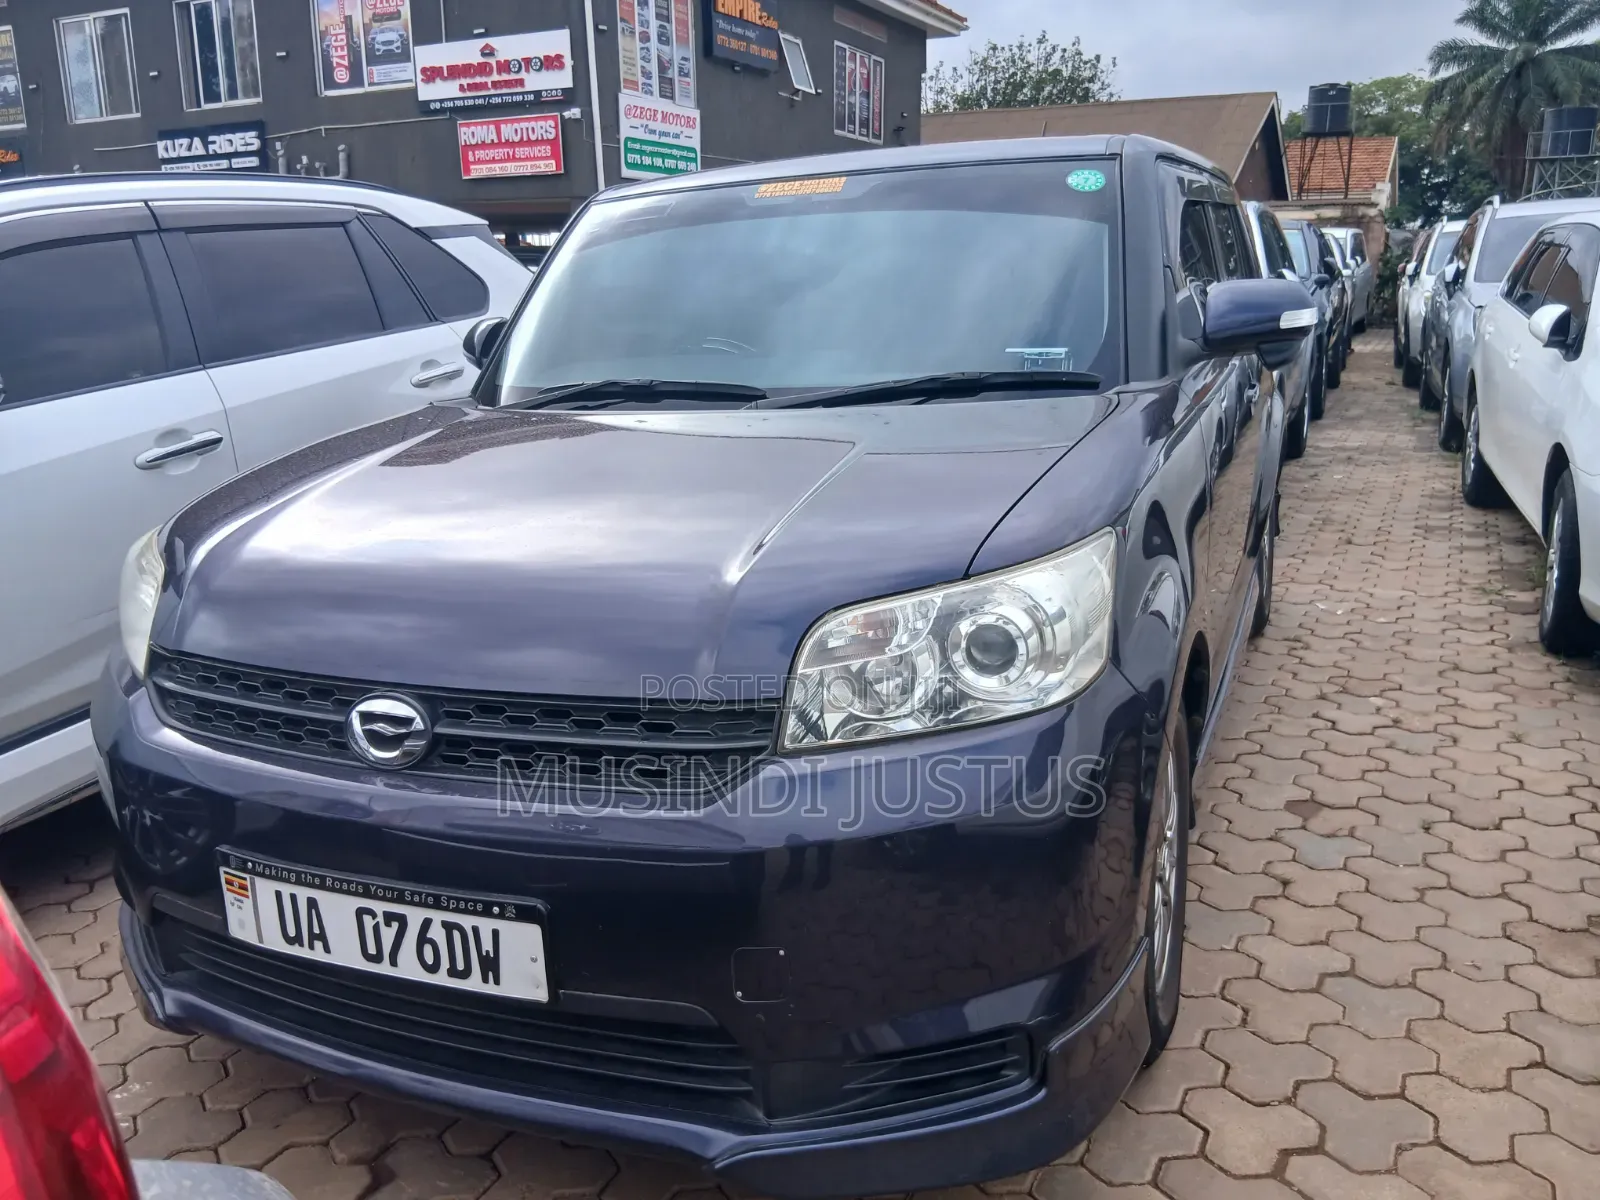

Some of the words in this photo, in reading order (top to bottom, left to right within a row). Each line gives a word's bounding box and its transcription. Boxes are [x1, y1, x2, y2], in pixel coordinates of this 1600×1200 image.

[420, 62, 493, 83] SPLENDID
[496, 54, 566, 76] MOTORS
[624, 104, 659, 121] @ZEGE
[660, 110, 697, 130] MOTORS
[157, 137, 207, 159] KUZA
[208, 131, 261, 154] RIDES
[460, 125, 499, 146] ROMA
[500, 120, 556, 143] MOTORS
[468, 151, 475, 162] &
[475, 147, 513, 161] PROPERTY
[515, 146, 551, 159] SERVICES
[255, 863, 296, 882] Making
[302, 873, 321, 884] the
[326, 877, 364, 893] Roads
[369, 885, 399, 899] Your
[405, 890, 434, 905] Safe
[440, 896, 484, 911] Space
[275, 889, 331, 954] UA
[355, 904, 501, 986] 076DW
